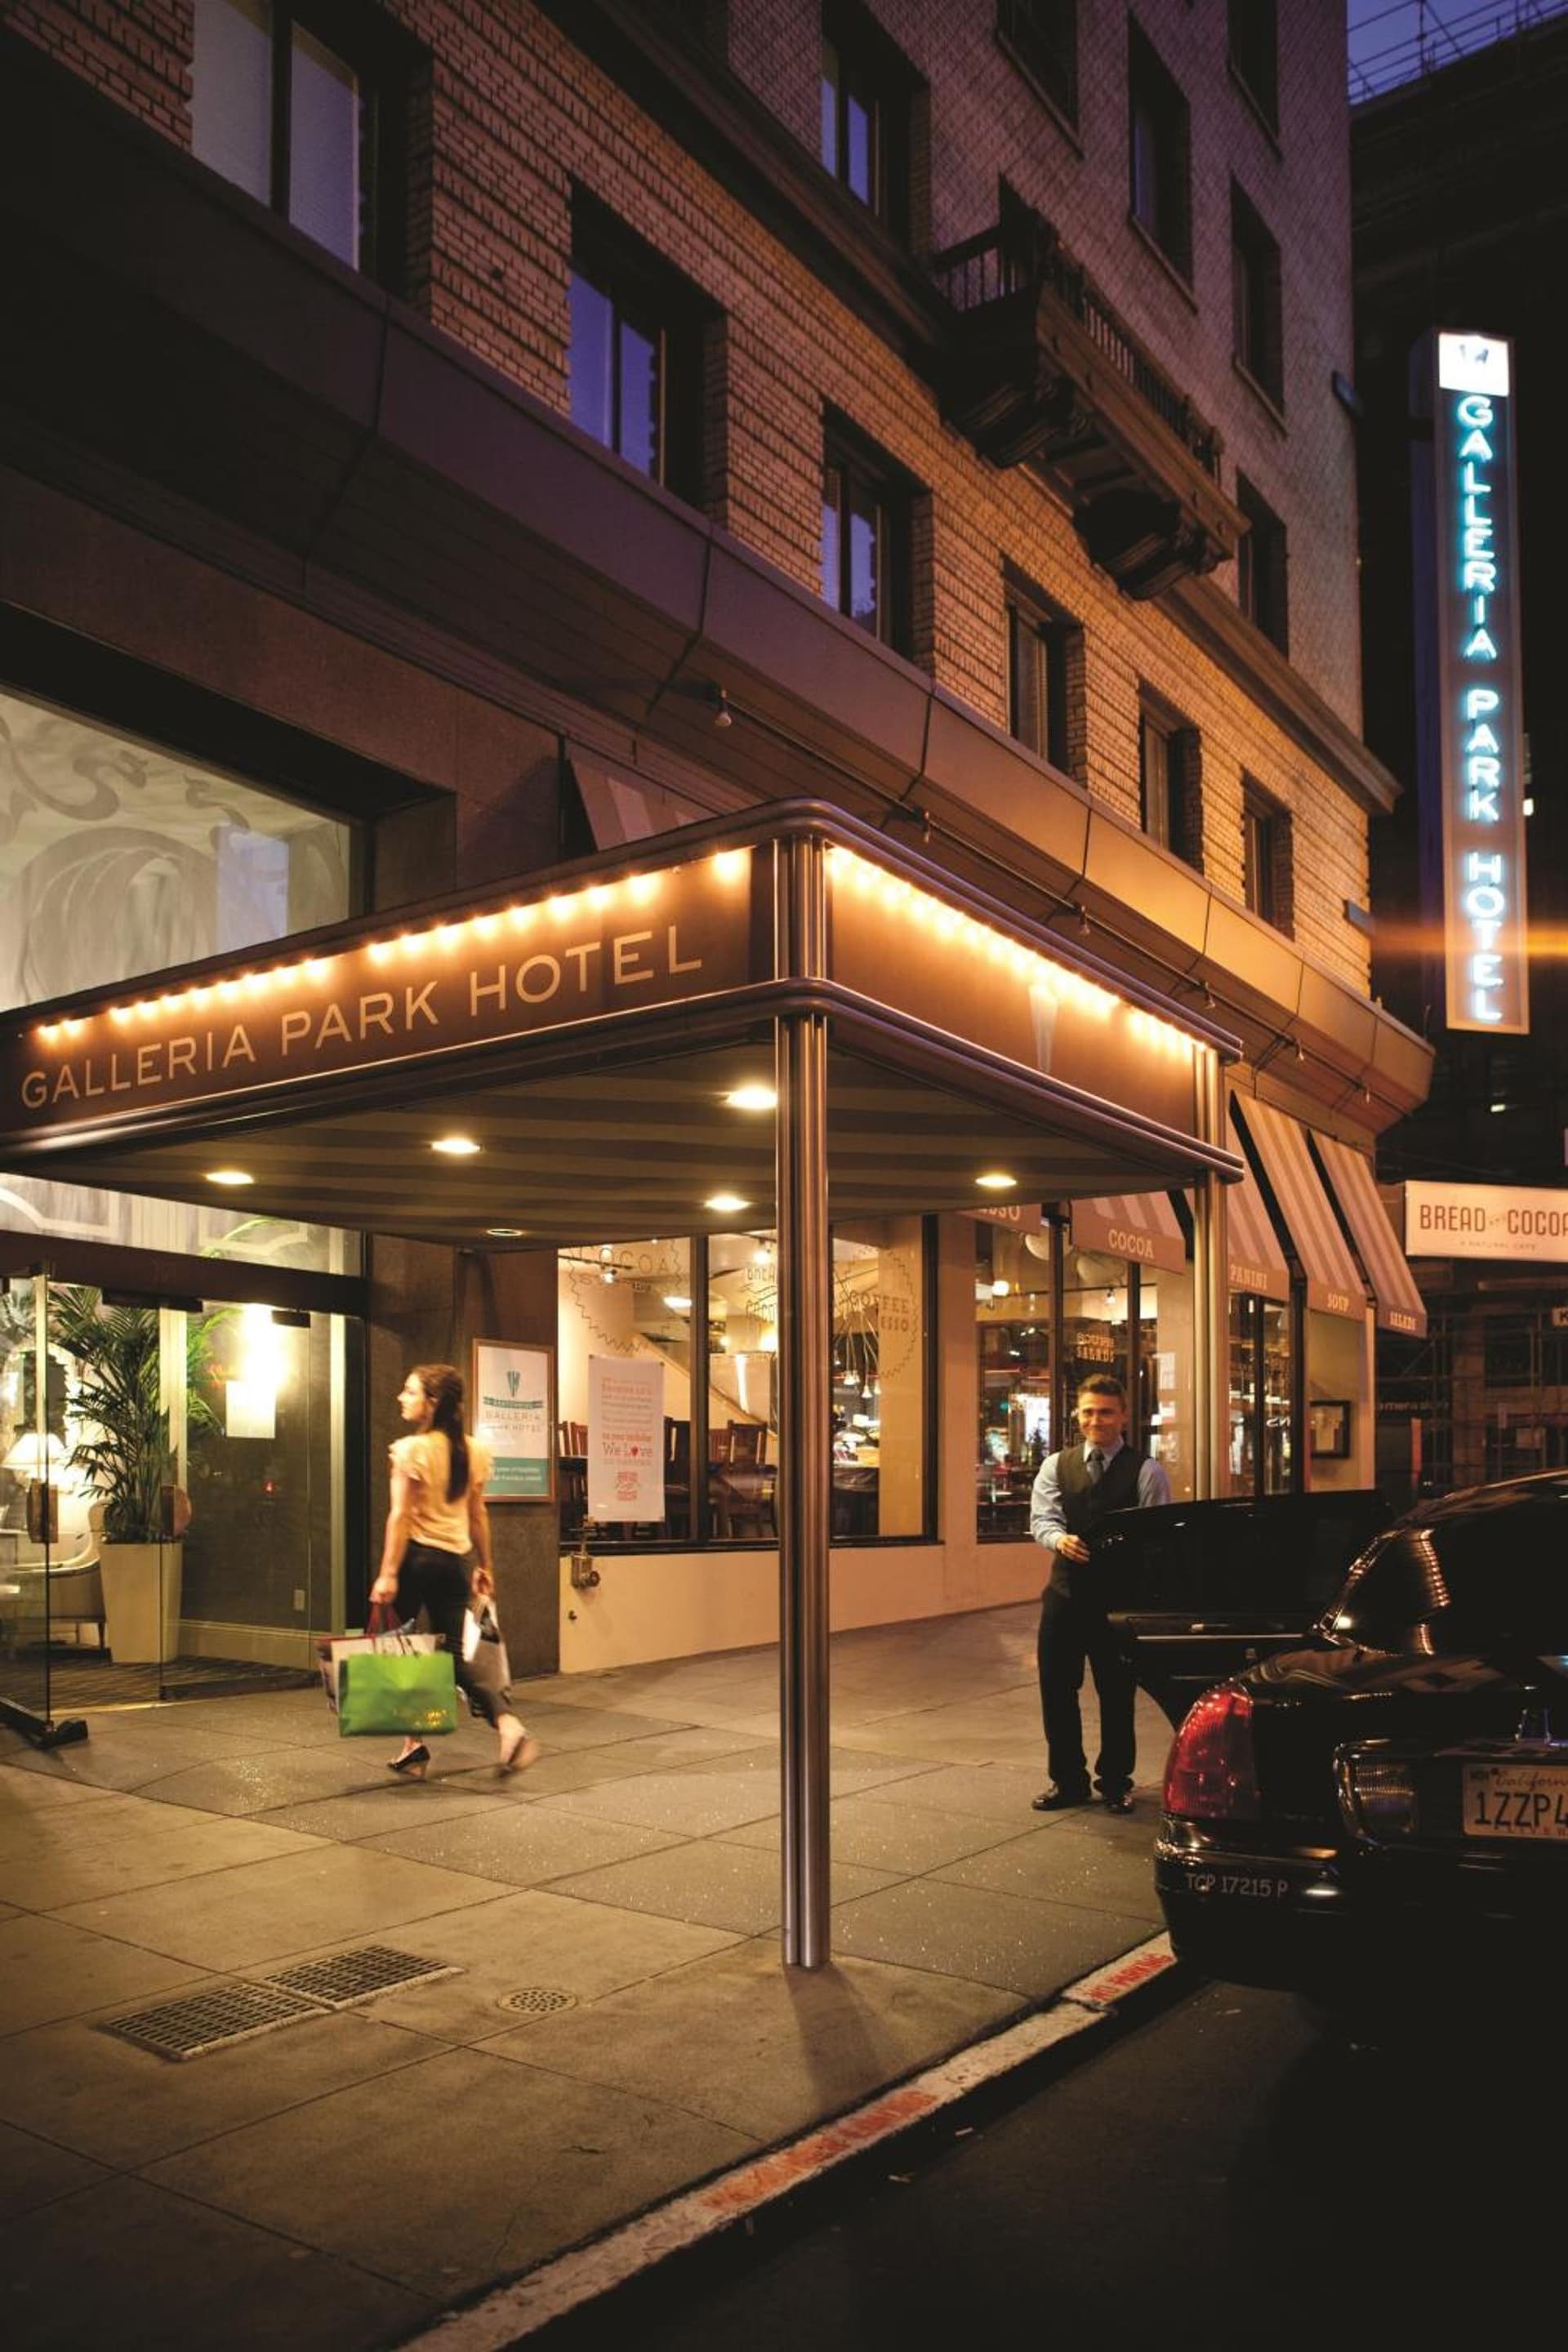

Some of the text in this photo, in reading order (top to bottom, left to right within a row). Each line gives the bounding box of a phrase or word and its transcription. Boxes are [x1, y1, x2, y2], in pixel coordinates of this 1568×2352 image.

[1458, 395, 1505, 1021] GALLERIA PARK HOTEL
[21, 924, 702, 1109] GALLERIA PARK HOTEL
[1419, 1204, 1486, 1232] BREAD
[1107, 1228, 1155, 1259] COCOA
[1229, 1264, 1267, 1290] PANINI
[1327, 1293, 1350, 1312] SOUP
[1186, 1873, 1216, 1891] TCP
[1277, 1880, 1289, 1897] P
